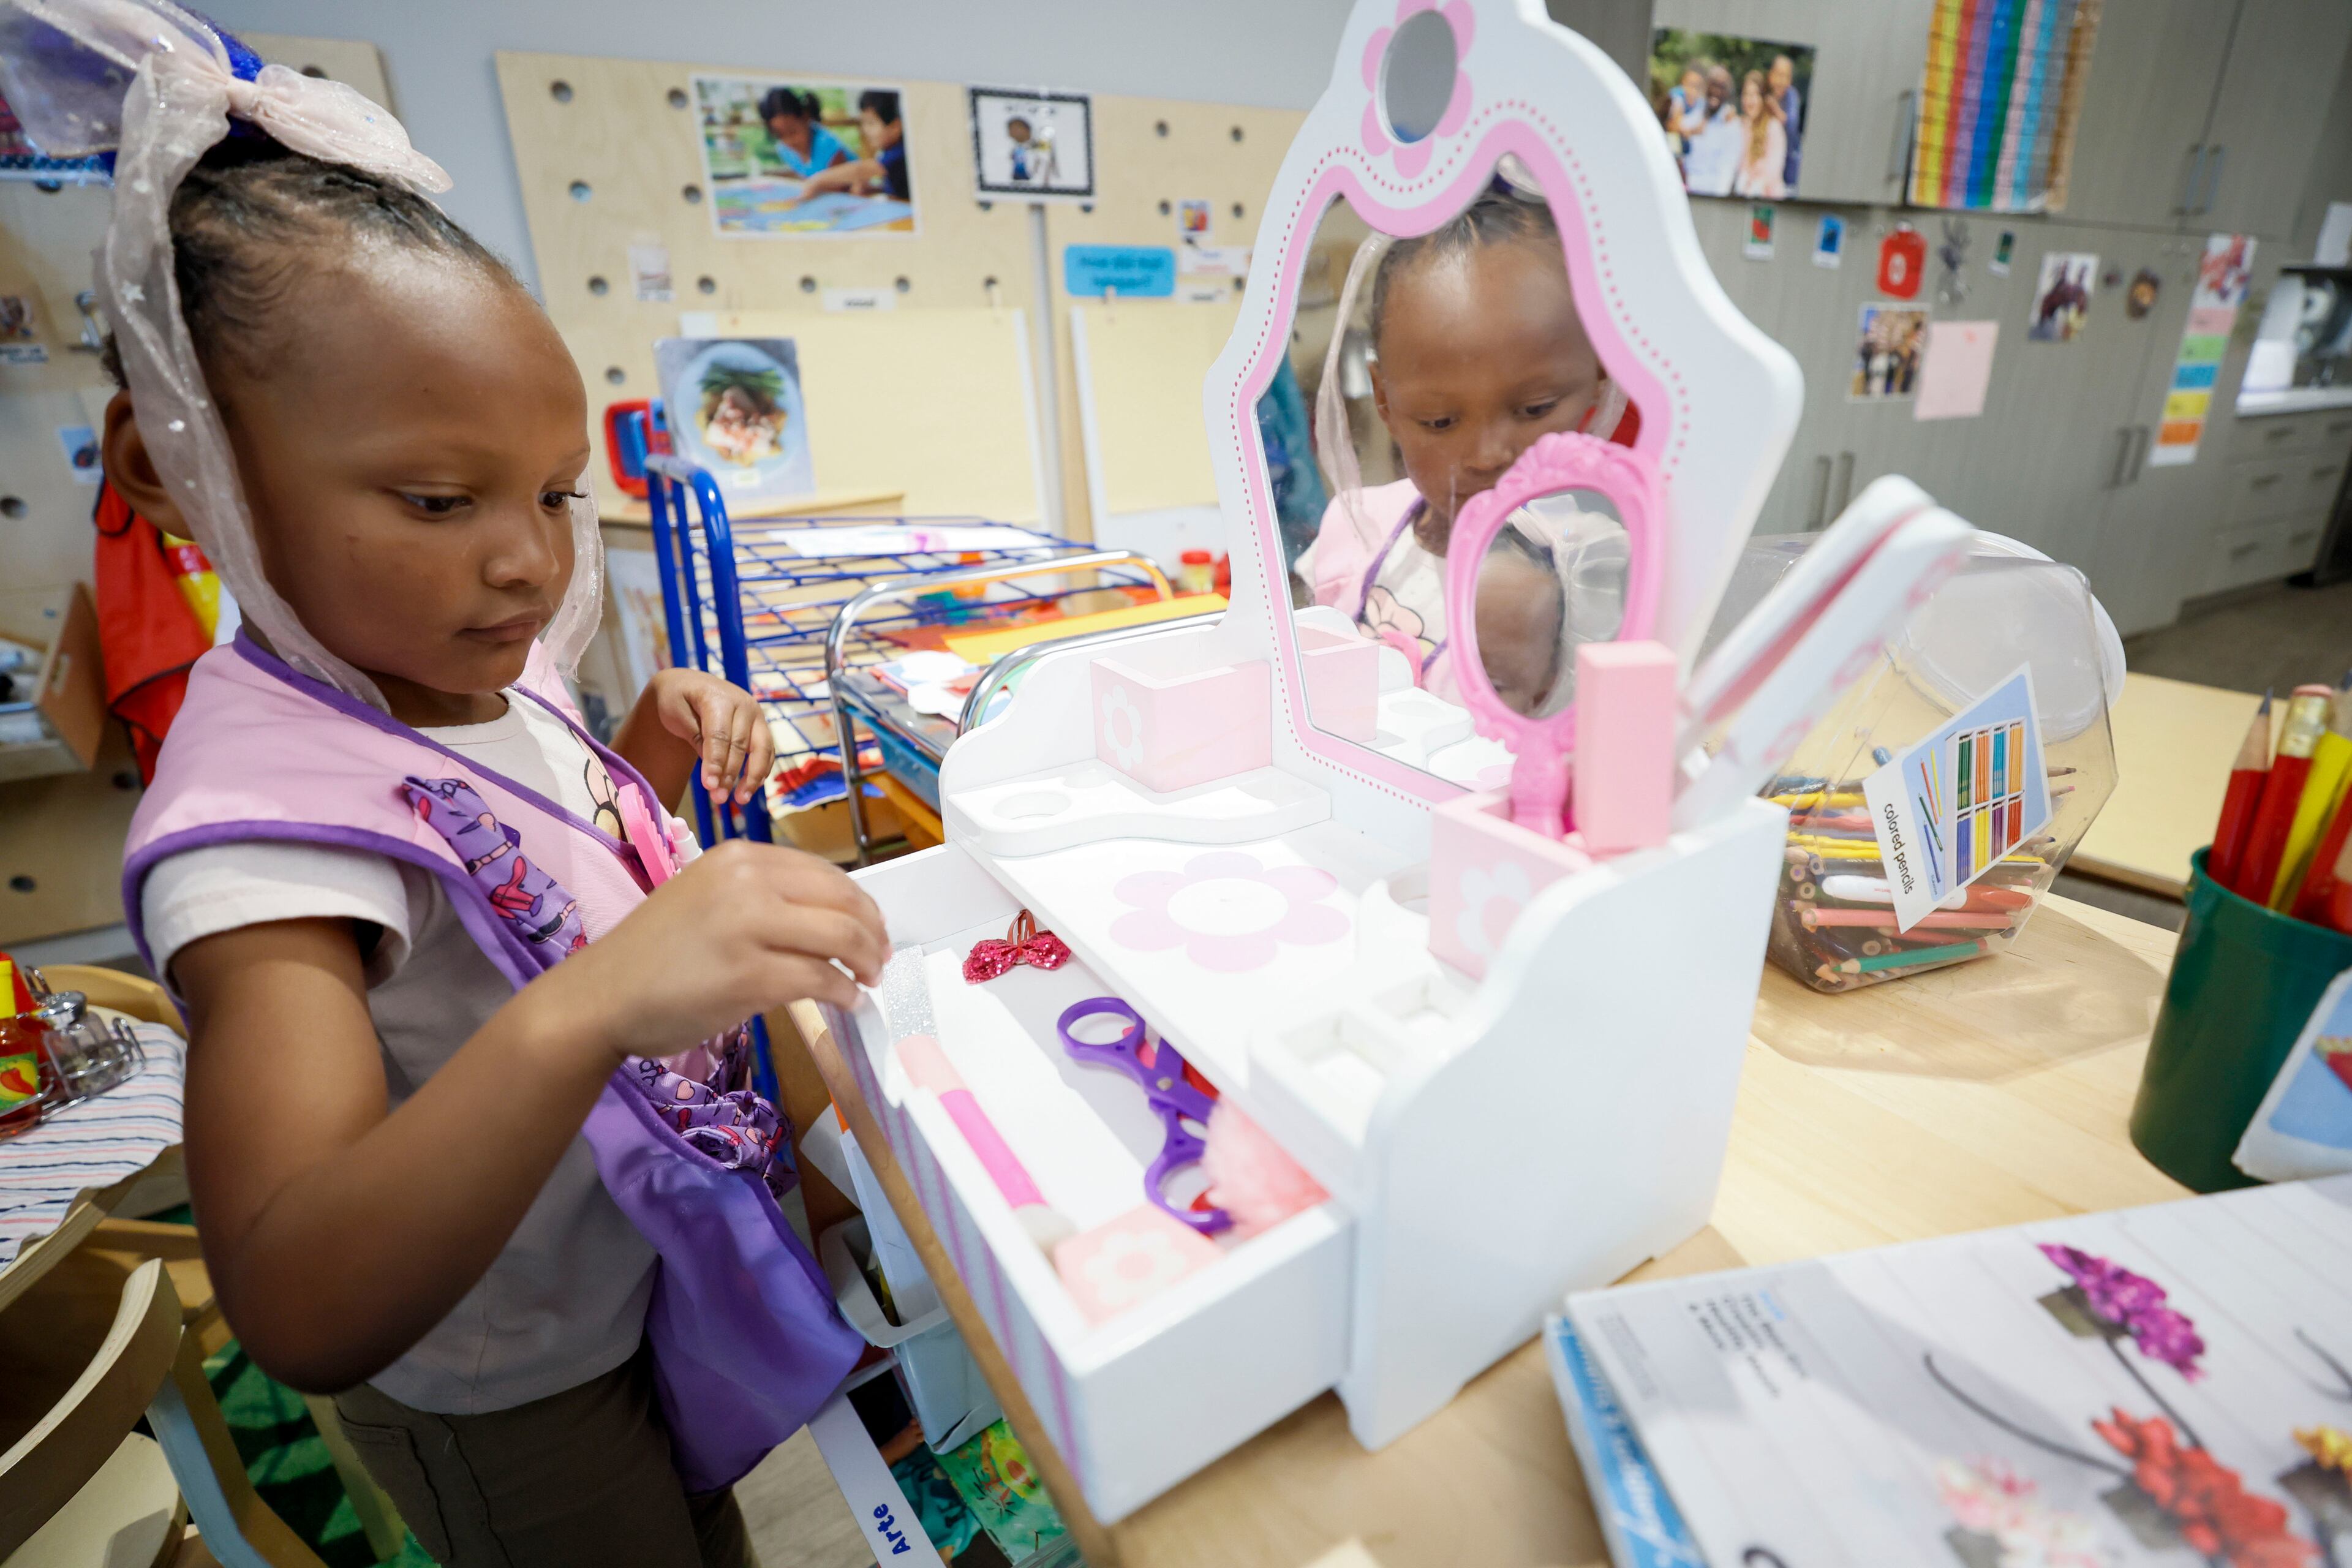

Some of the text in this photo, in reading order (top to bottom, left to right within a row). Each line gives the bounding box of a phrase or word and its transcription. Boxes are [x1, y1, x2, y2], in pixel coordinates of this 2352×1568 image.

[1884, 803, 1915, 895] colored pencils
[873, 1503, 911, 1555] Arte
